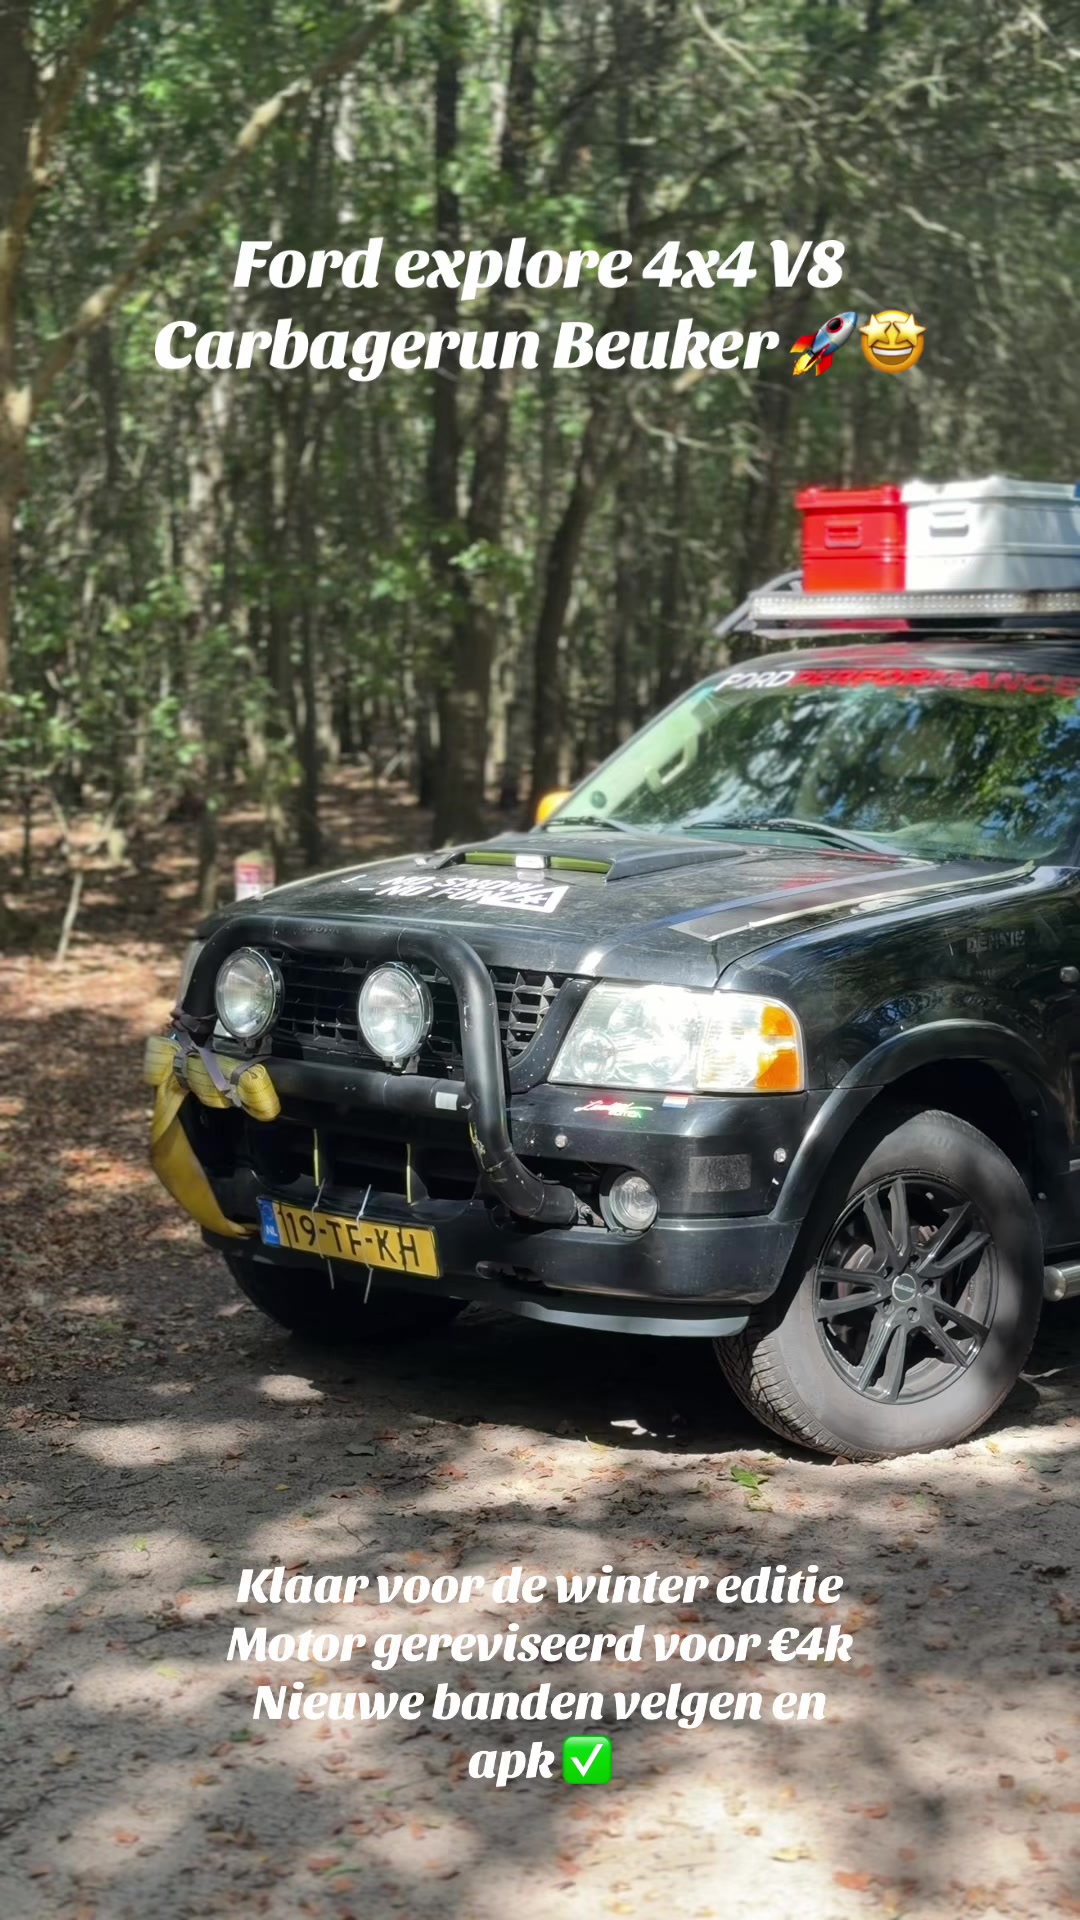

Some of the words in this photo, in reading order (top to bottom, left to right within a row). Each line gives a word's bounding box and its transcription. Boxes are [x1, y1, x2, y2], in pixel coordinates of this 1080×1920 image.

[714, 669, 796, 690] FORD
[787, 666, 1080, 697] PERFORMANCE
[265, 1225, 279, 1237] NL
